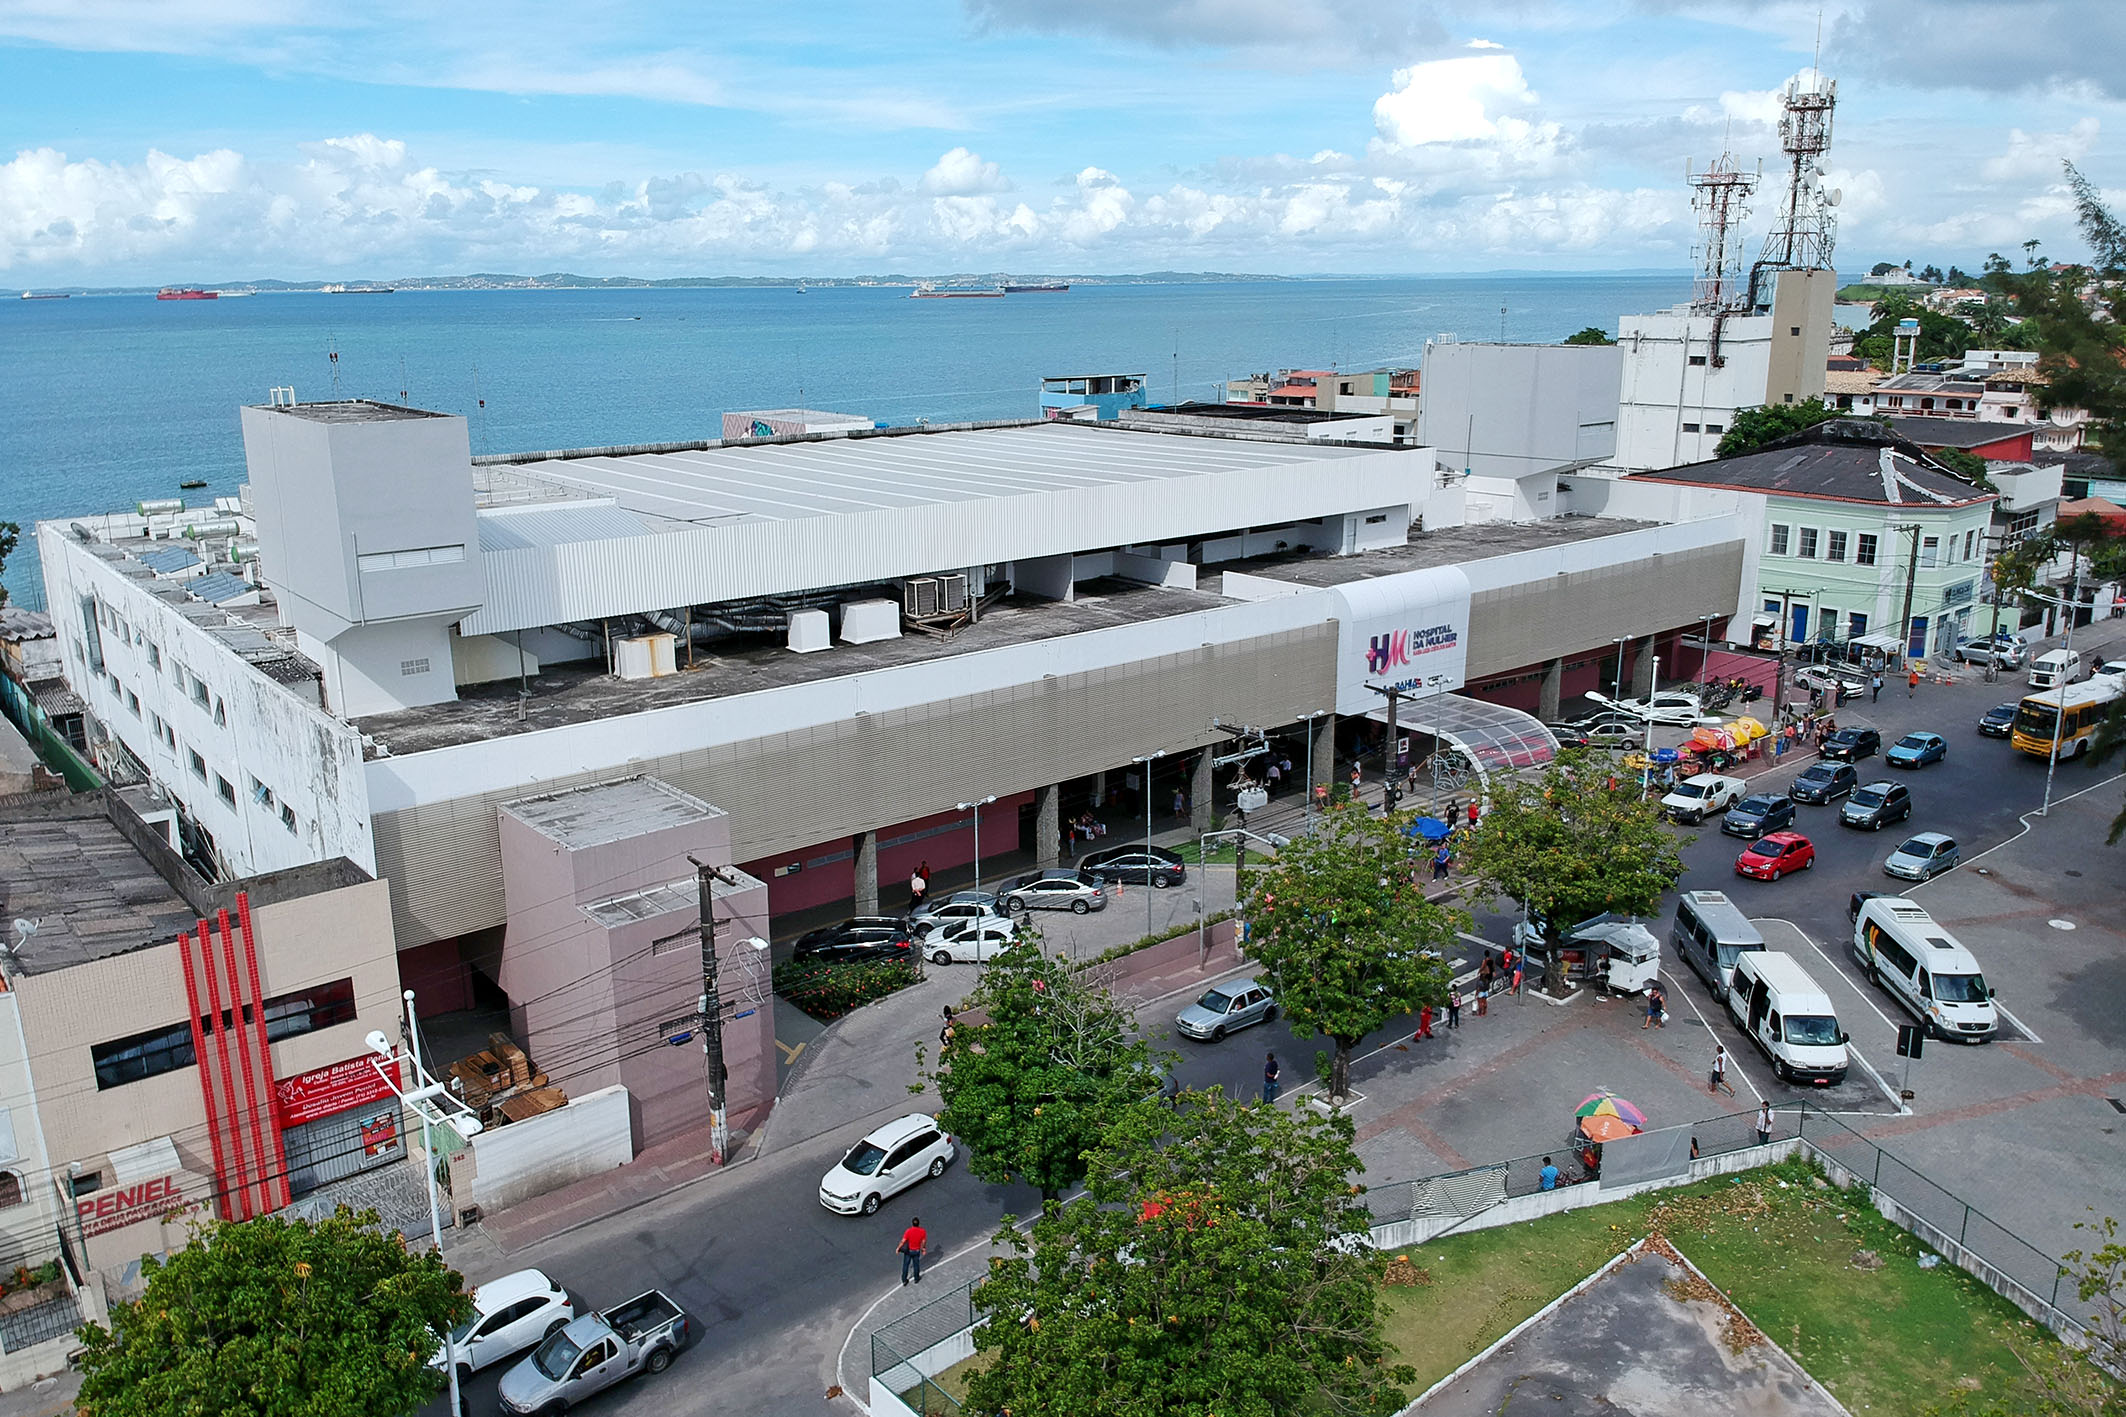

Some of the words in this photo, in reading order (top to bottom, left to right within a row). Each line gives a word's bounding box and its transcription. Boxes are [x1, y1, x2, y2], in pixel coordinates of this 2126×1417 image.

[1413, 624, 1453, 640] HOSPITAL
[1413, 640, 1424, 650] DA
[1426, 633, 1457, 647] MULHER
[302, 1070, 329, 1084] Igreja
[331, 1060, 364, 1075] Batista
[78, 1175, 181, 1219] PENIEL
[100, 1213, 125, 1226] DEUS
